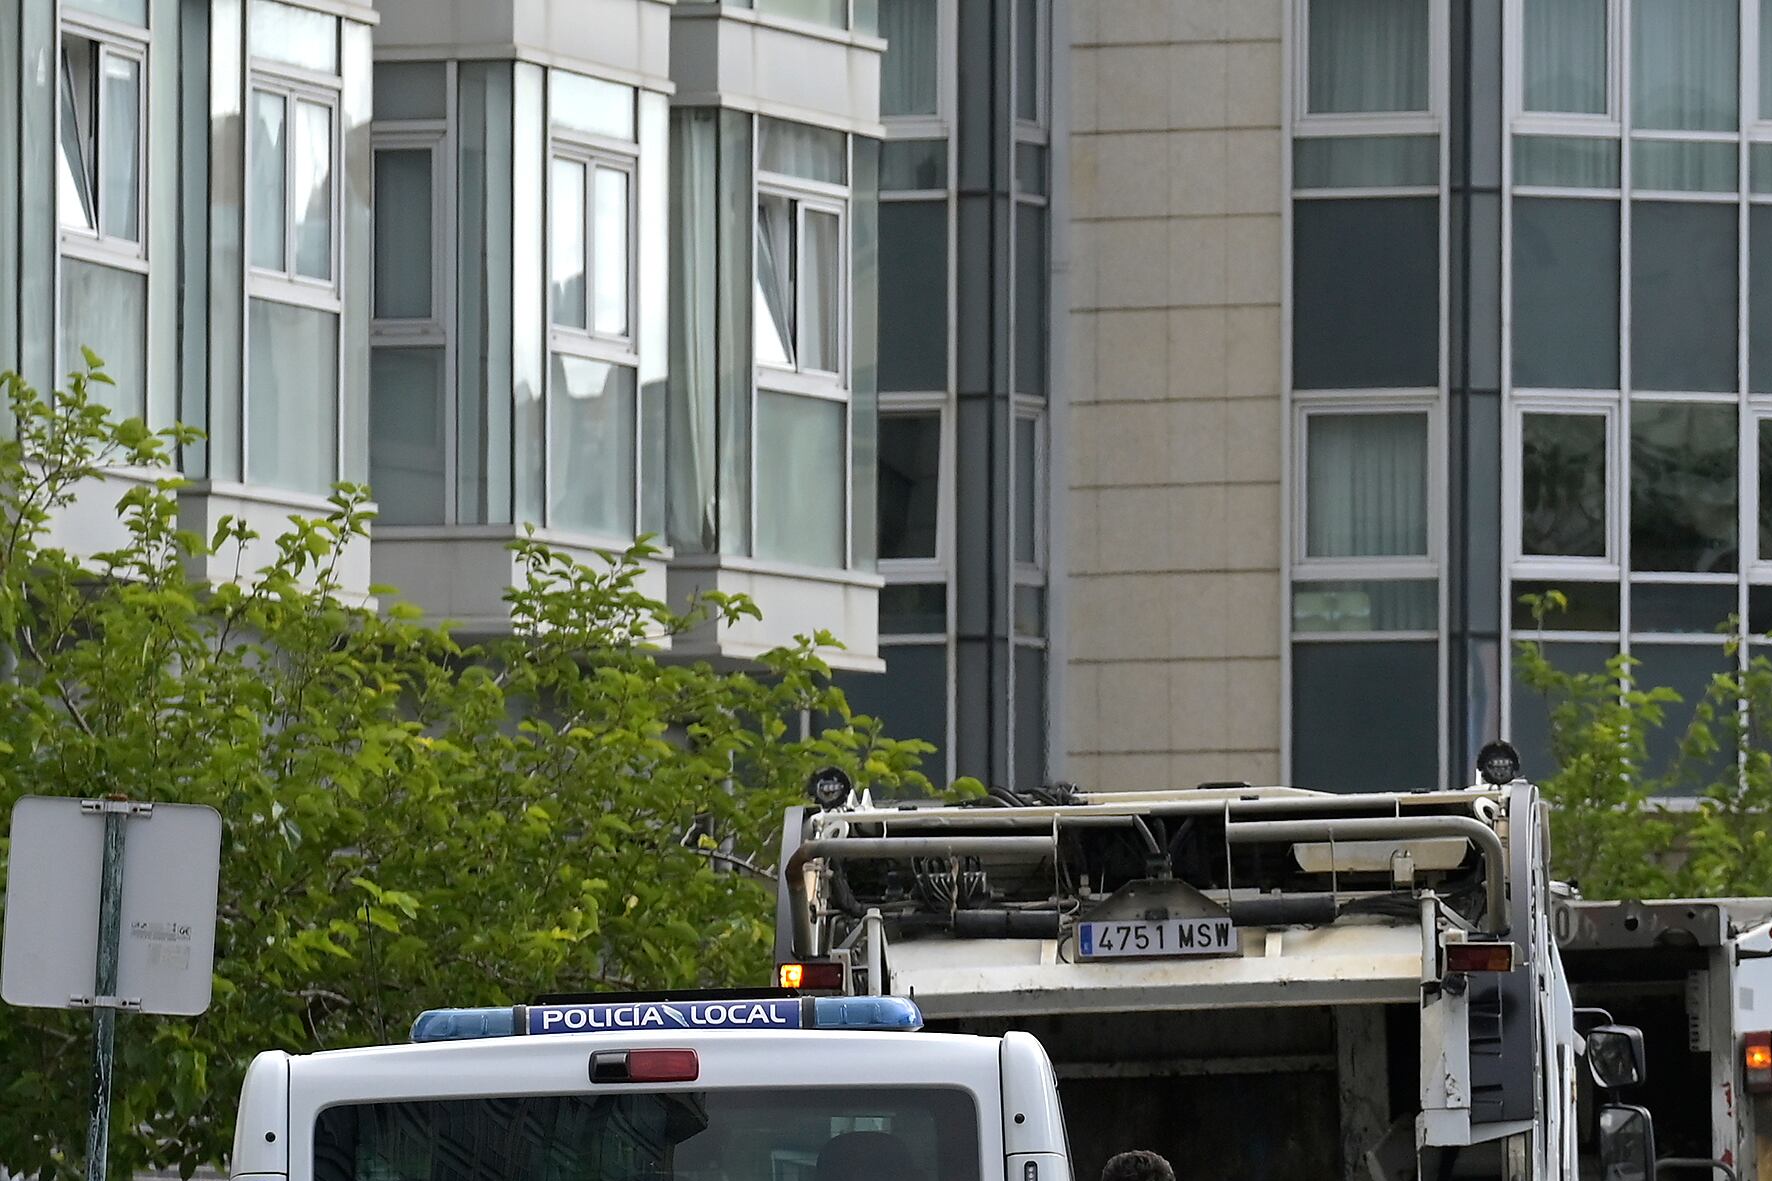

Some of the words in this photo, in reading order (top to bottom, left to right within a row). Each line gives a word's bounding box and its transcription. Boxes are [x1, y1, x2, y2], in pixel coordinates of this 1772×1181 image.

[1098, 925, 1164, 951] 4751
[1178, 922, 1230, 949] MSW
[543, 1003, 664, 1030] POLICÍA
[690, 1003, 786, 1024] LOCAL
